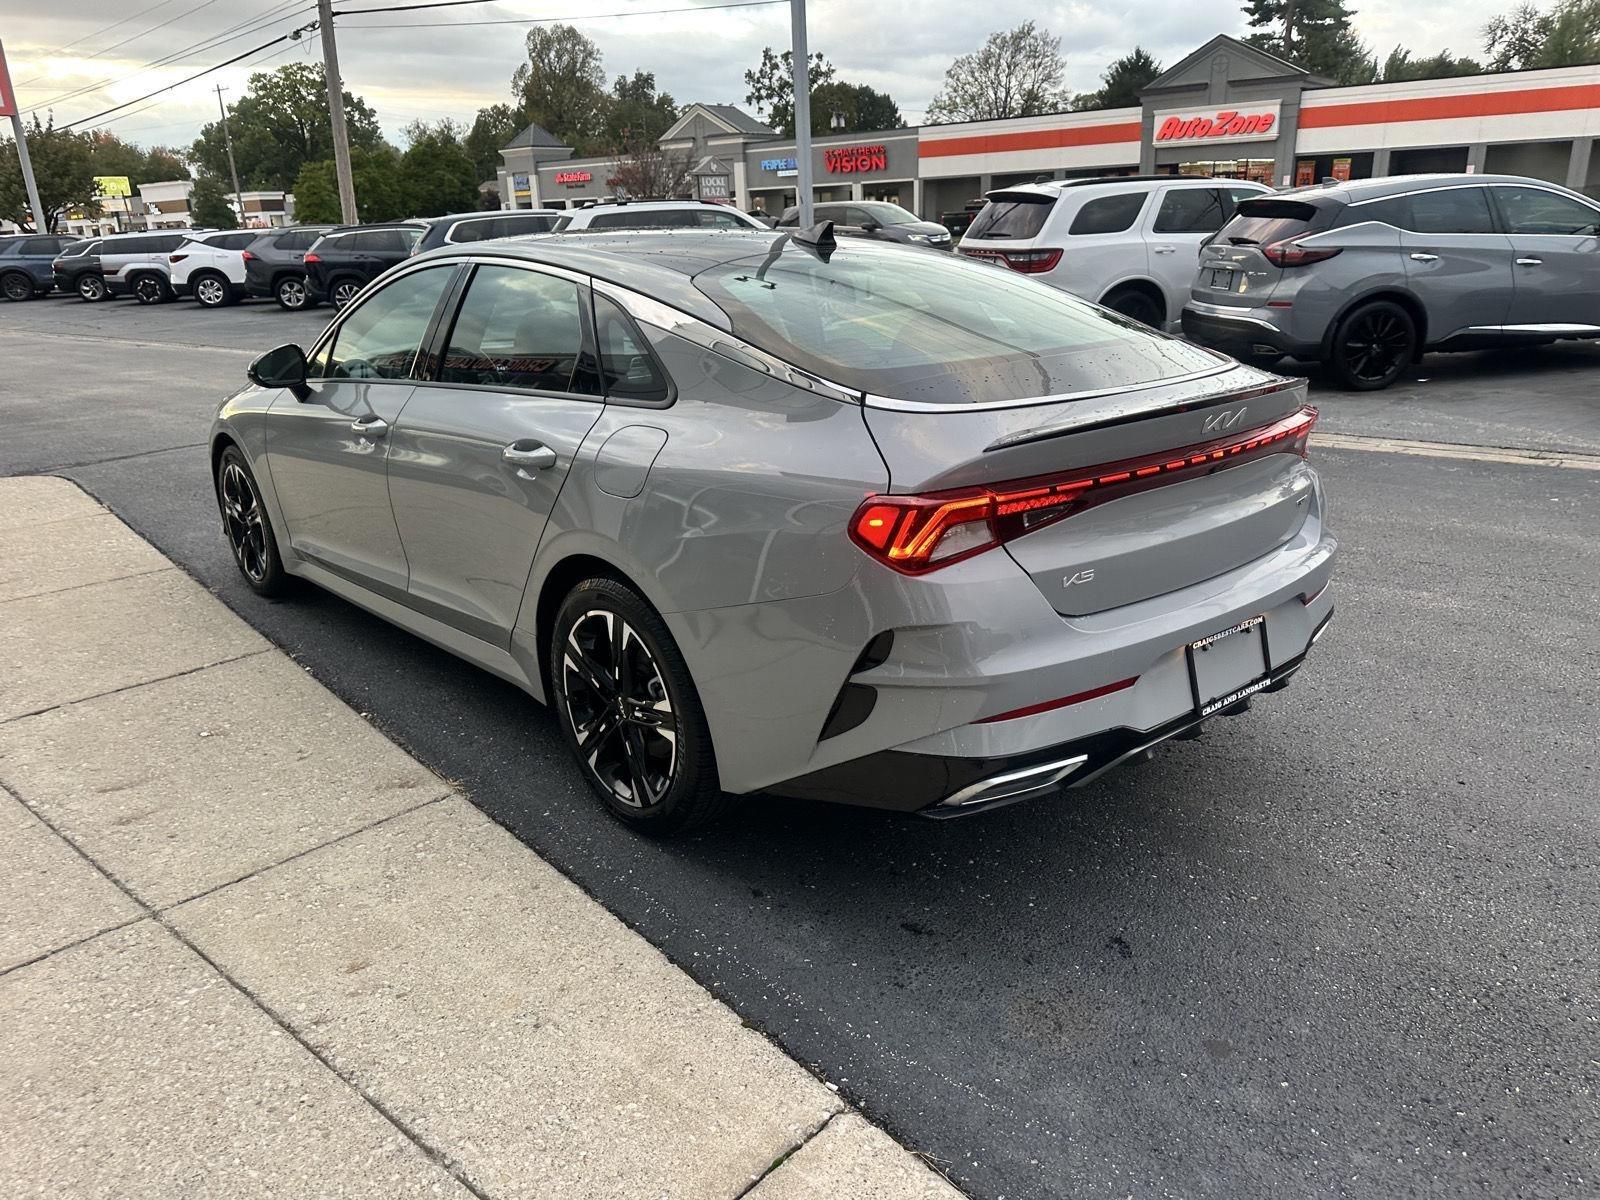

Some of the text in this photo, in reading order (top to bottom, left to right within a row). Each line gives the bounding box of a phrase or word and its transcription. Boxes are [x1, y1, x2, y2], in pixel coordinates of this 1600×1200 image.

[1156, 111, 1276, 141] AutoZone
[835, 145, 886, 158] MATTHEWS
[825, 156, 887, 173] VISION
[701, 176, 726, 186] LOCKE
[702, 186, 726, 196] PLAZA
[1062, 569, 1095, 589] K5
[1202, 678, 1271, 716] CRAIG AND LANDRETH
